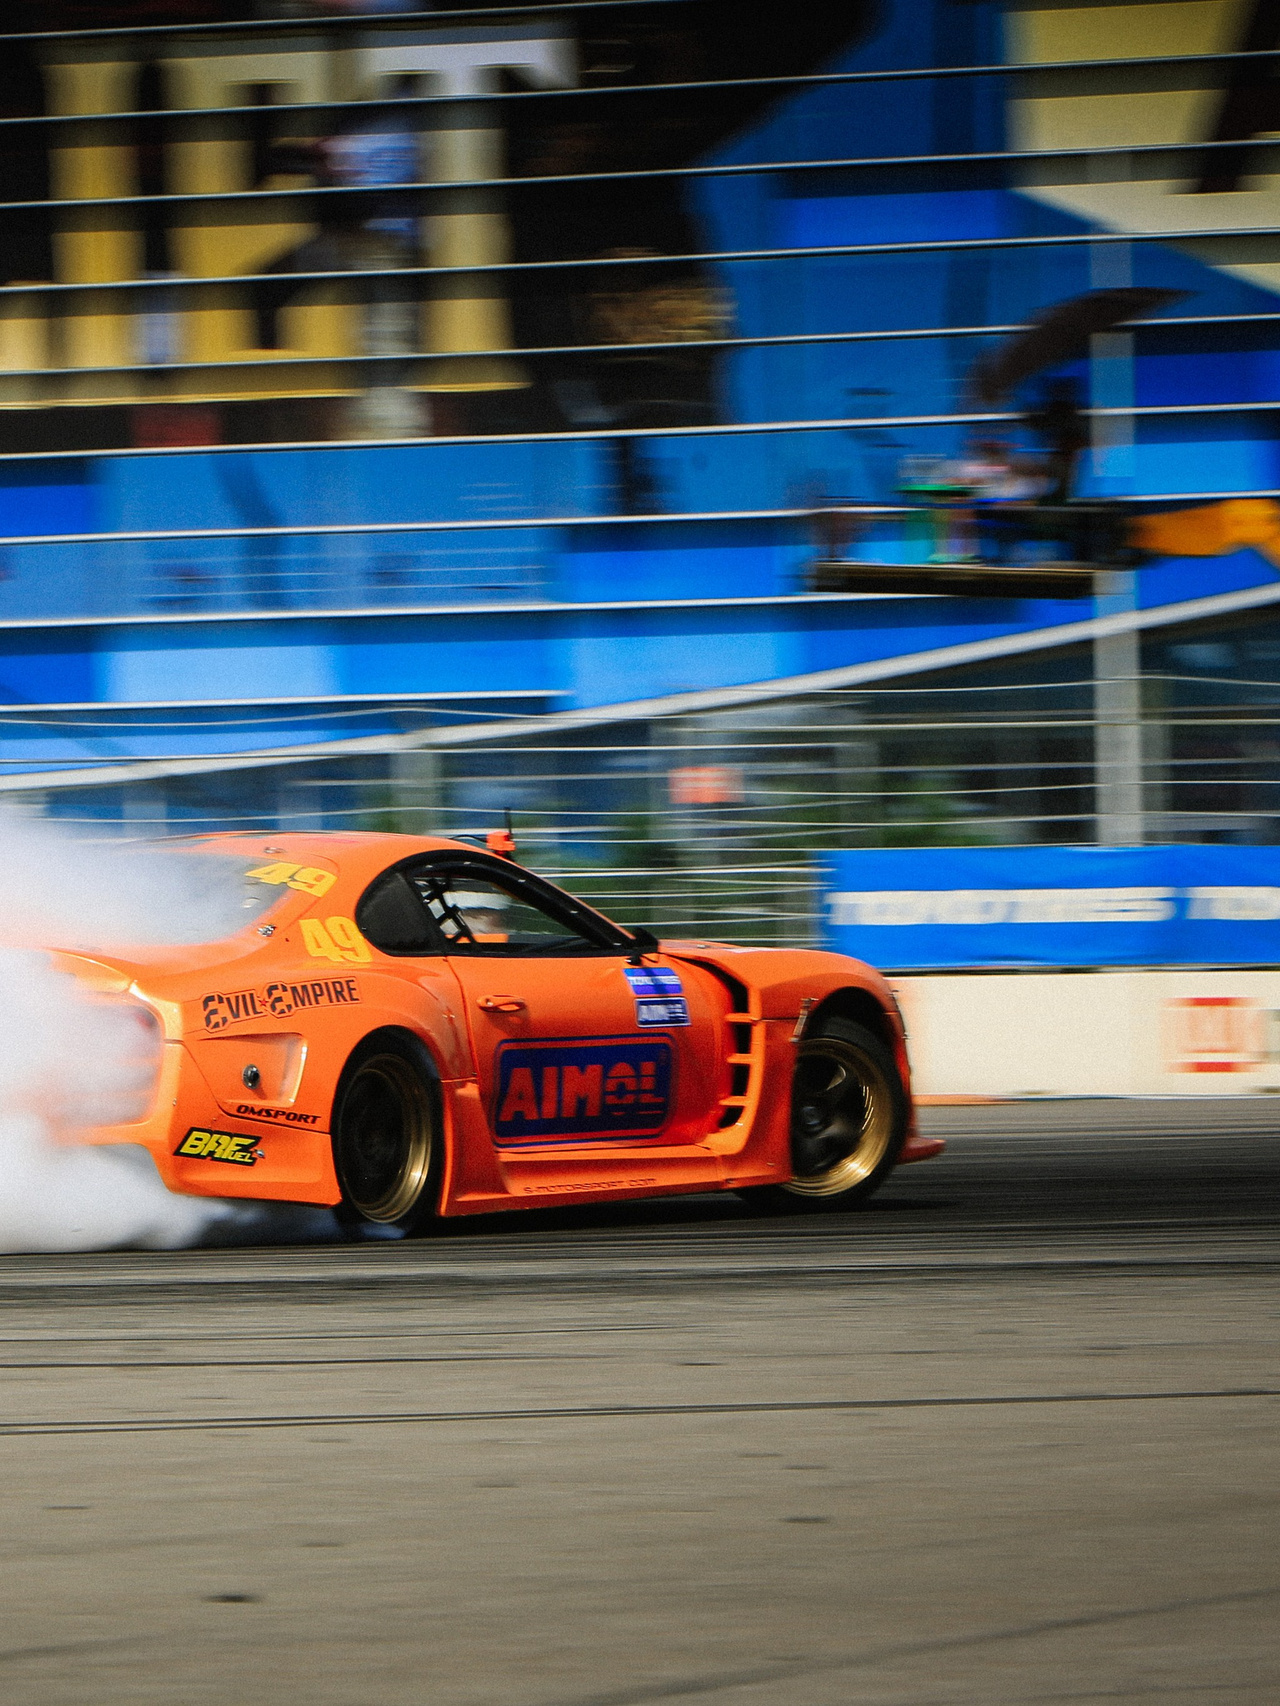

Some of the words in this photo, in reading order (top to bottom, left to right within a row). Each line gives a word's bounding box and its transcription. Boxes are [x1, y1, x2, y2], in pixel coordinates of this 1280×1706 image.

[245, 861, 338, 898] 49
[298, 916, 373, 963] 49
[202, 992, 264, 1030] EVIL
[266, 978, 360, 1015] EMPIRE
[236, 1104, 322, 1125] OMSPORT
[498, 1060, 666, 1123] AIMOL
